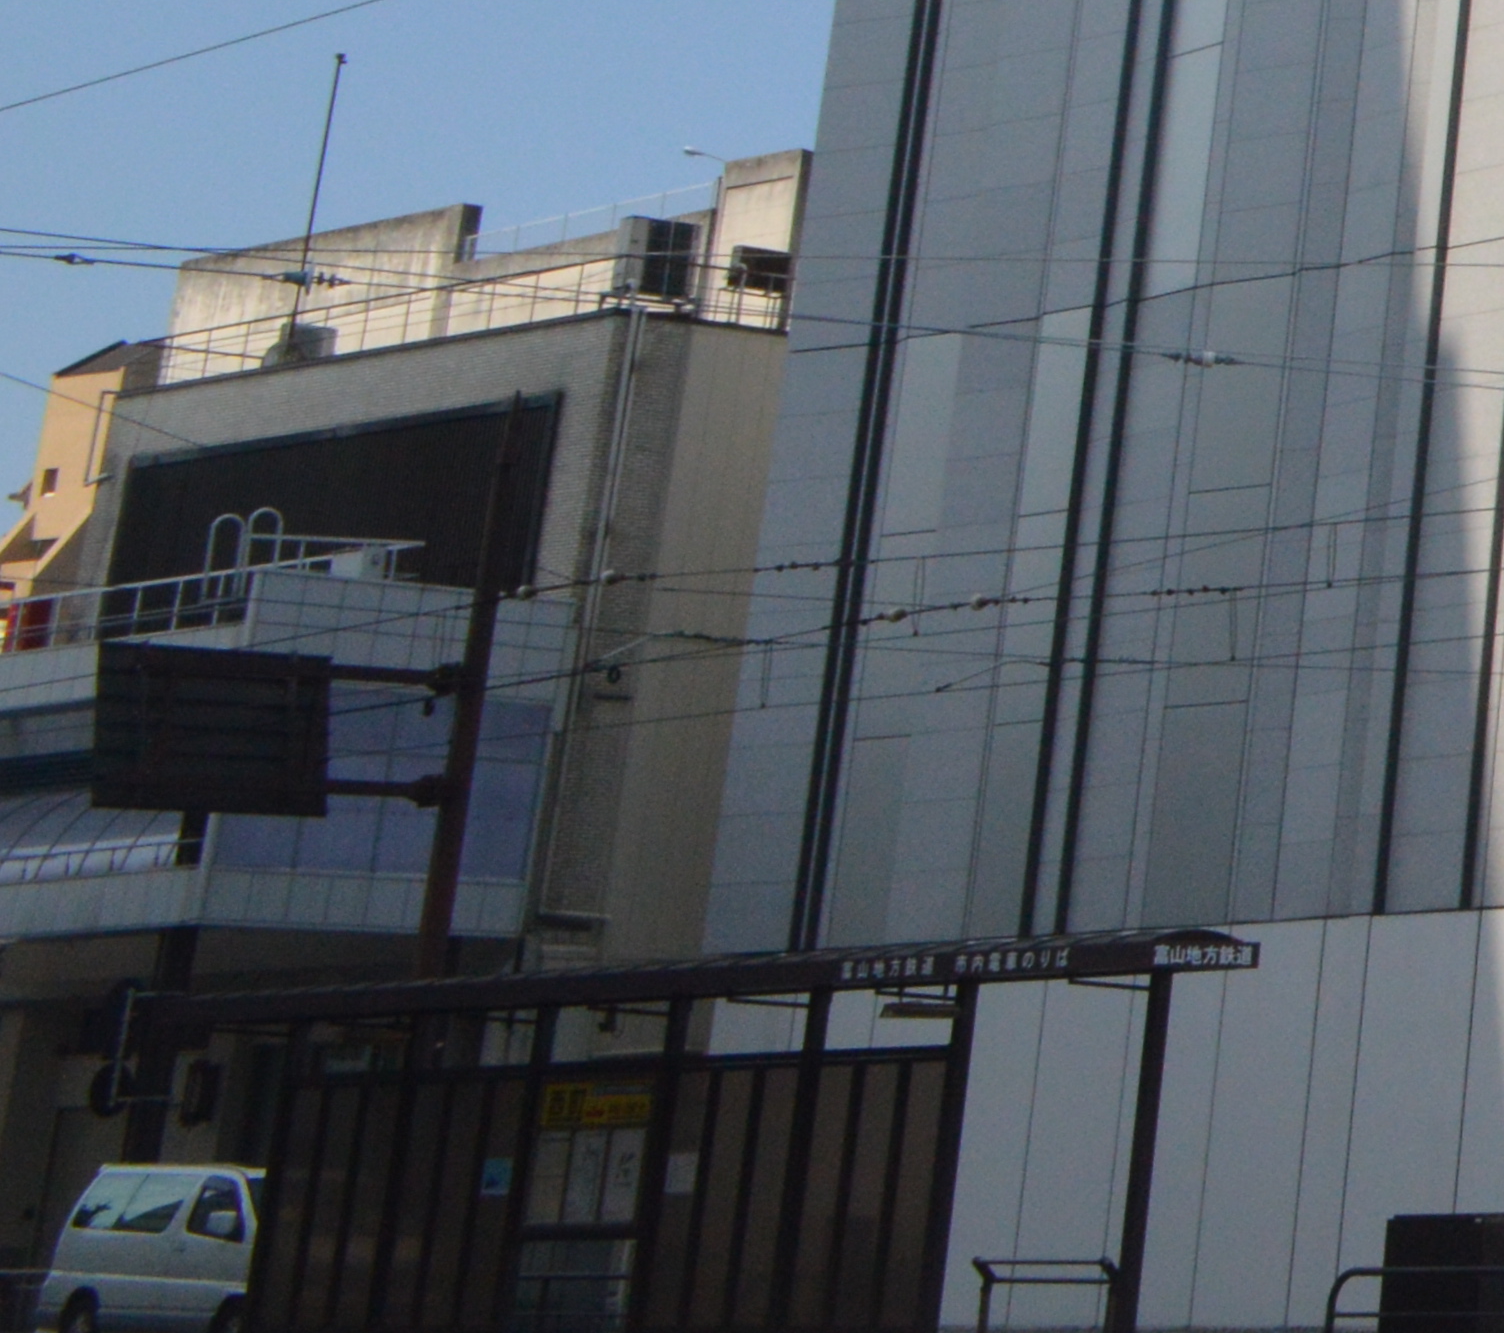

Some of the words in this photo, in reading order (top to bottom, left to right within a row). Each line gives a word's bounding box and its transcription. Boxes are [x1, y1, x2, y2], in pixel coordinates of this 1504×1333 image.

[840, 955, 935, 981] 富山地方鉄道
[953, 946, 1071, 974] 市内電車のりば
[1153, 943, 1254, 967] 富山地方鉄道
